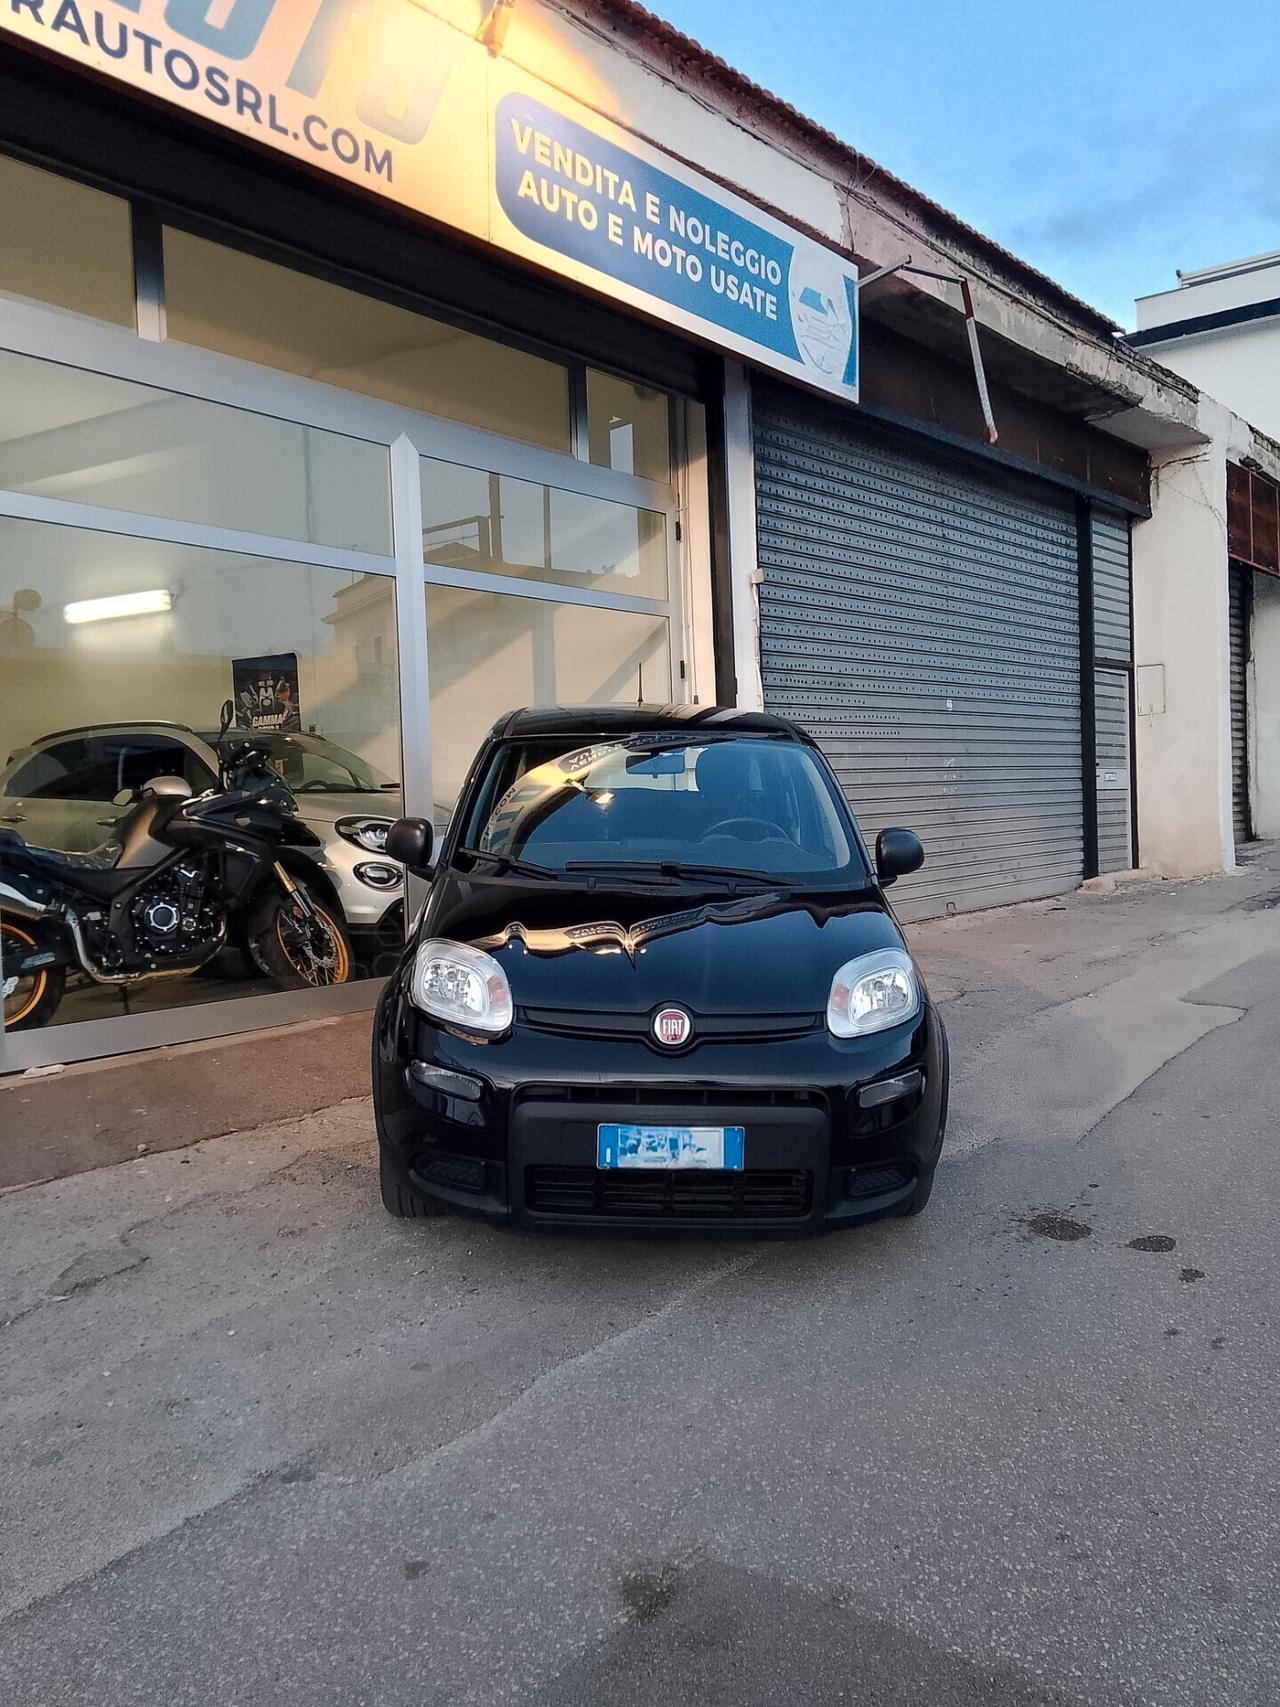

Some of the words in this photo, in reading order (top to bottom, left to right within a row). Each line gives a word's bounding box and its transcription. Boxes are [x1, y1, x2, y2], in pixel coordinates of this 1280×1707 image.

[511, 117, 636, 212] VENDITA
[645, 191, 661, 224] E
[669, 205, 782, 286] NOLEGGIO
[517, 169, 599, 231] AUTO
[608, 212, 624, 246] E
[633, 225, 703, 283] MOTO
[710, 264, 777, 321] USATE
[662, 1018, 683, 1036] FIAT
